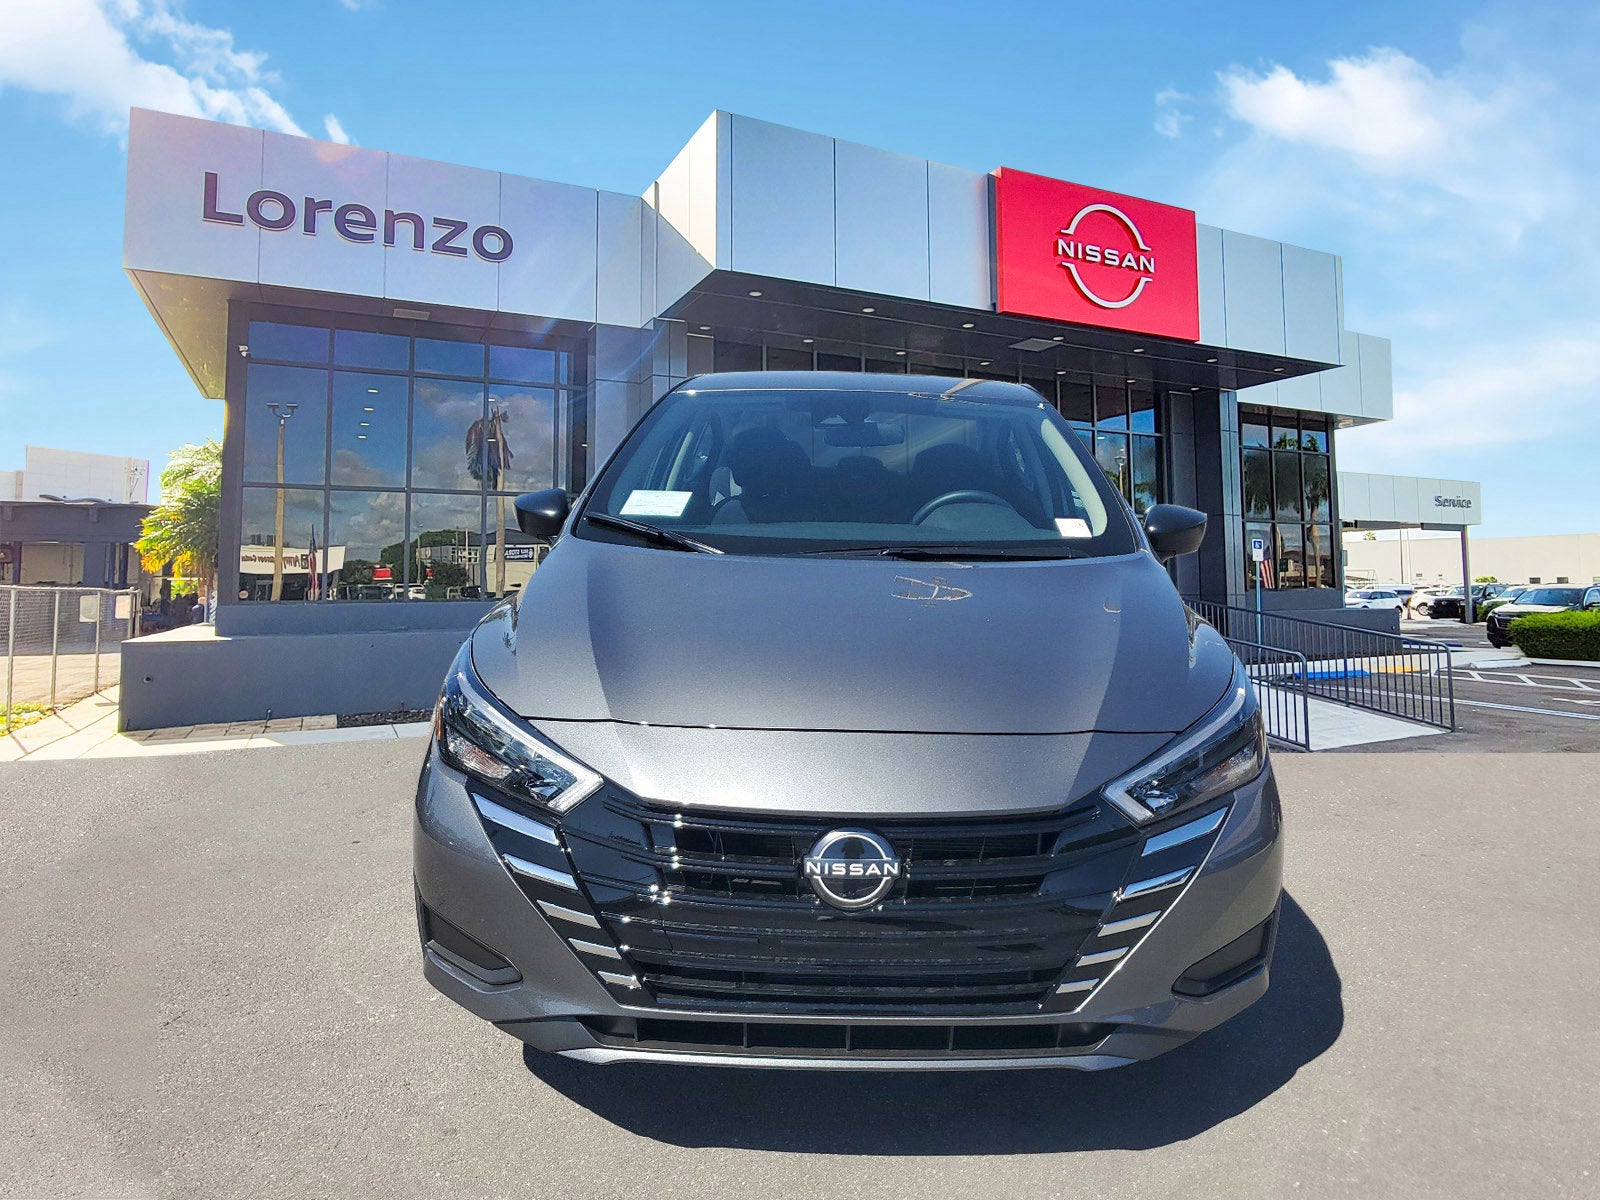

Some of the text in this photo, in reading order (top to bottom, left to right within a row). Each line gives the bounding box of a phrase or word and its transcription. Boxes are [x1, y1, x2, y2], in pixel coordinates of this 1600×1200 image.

[202, 171, 515, 262] Lorenzo
[1057, 238, 1155, 273] NISSAN
[1434, 495, 1472, 509] Service
[806, 861, 899, 876] NISSAN
